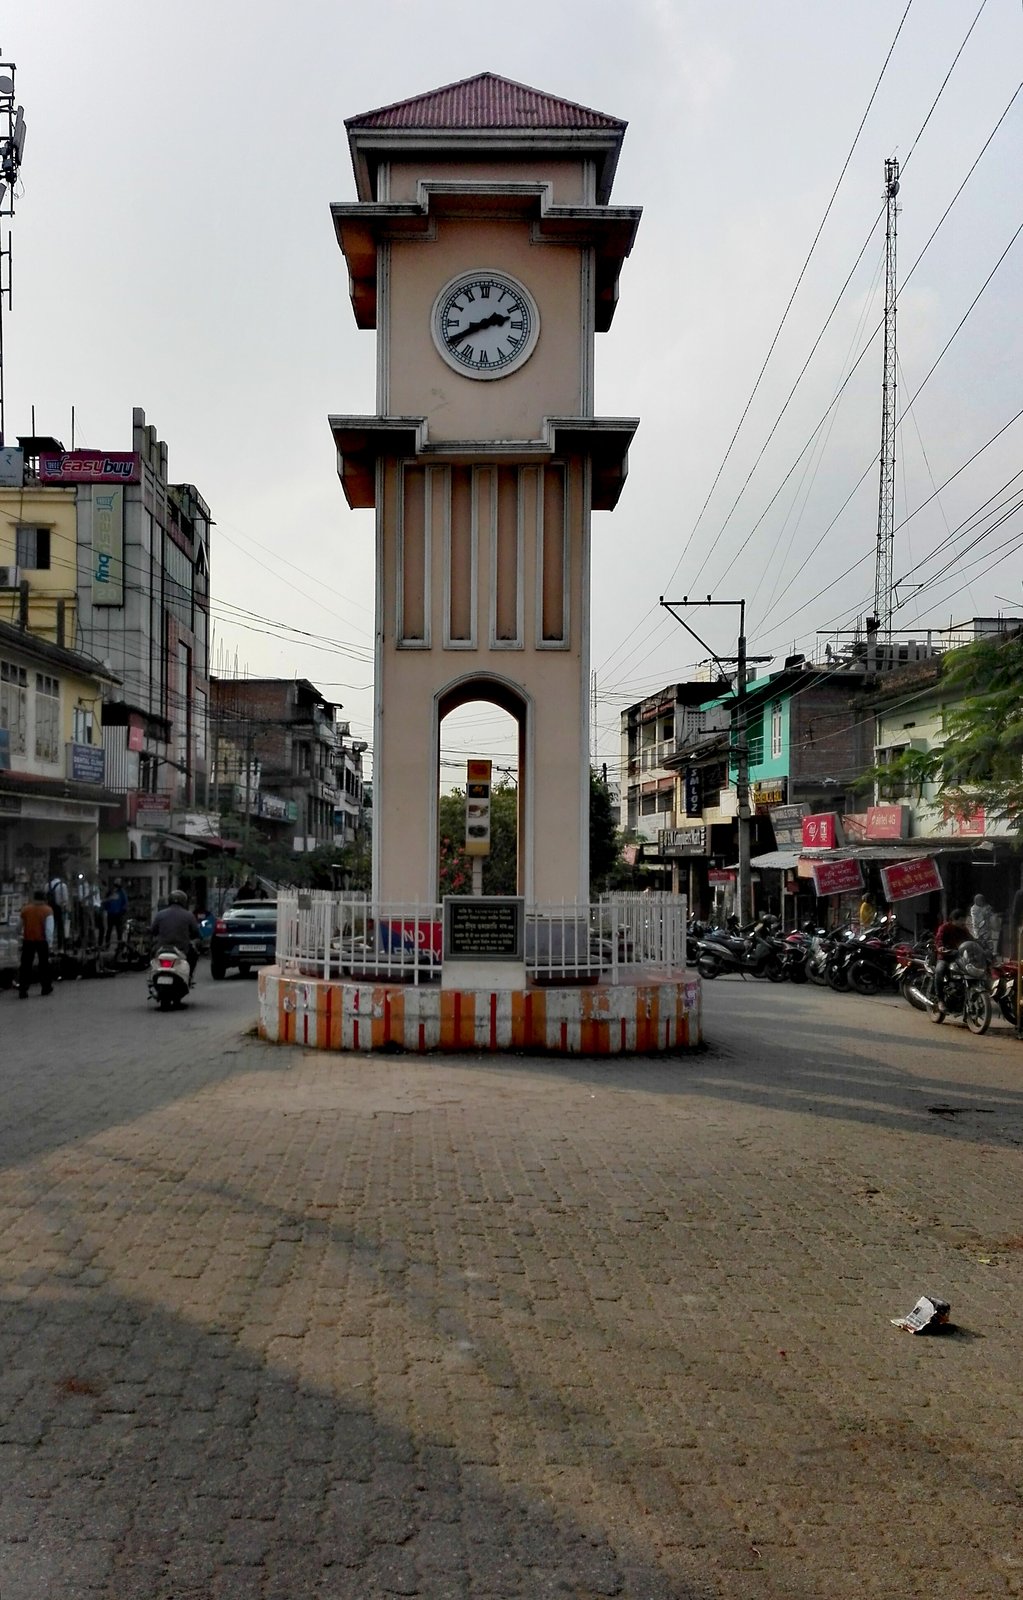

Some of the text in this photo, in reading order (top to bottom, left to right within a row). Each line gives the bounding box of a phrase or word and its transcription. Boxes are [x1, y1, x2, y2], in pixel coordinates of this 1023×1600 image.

[480, 285, 491, 299] XII
[507, 304, 520, 314] II
[510, 321, 523, 330] III
[62, 459, 134, 477] easybuy
[403, 929, 426, 943] NO
[393, 946, 441, 962] ENRY
